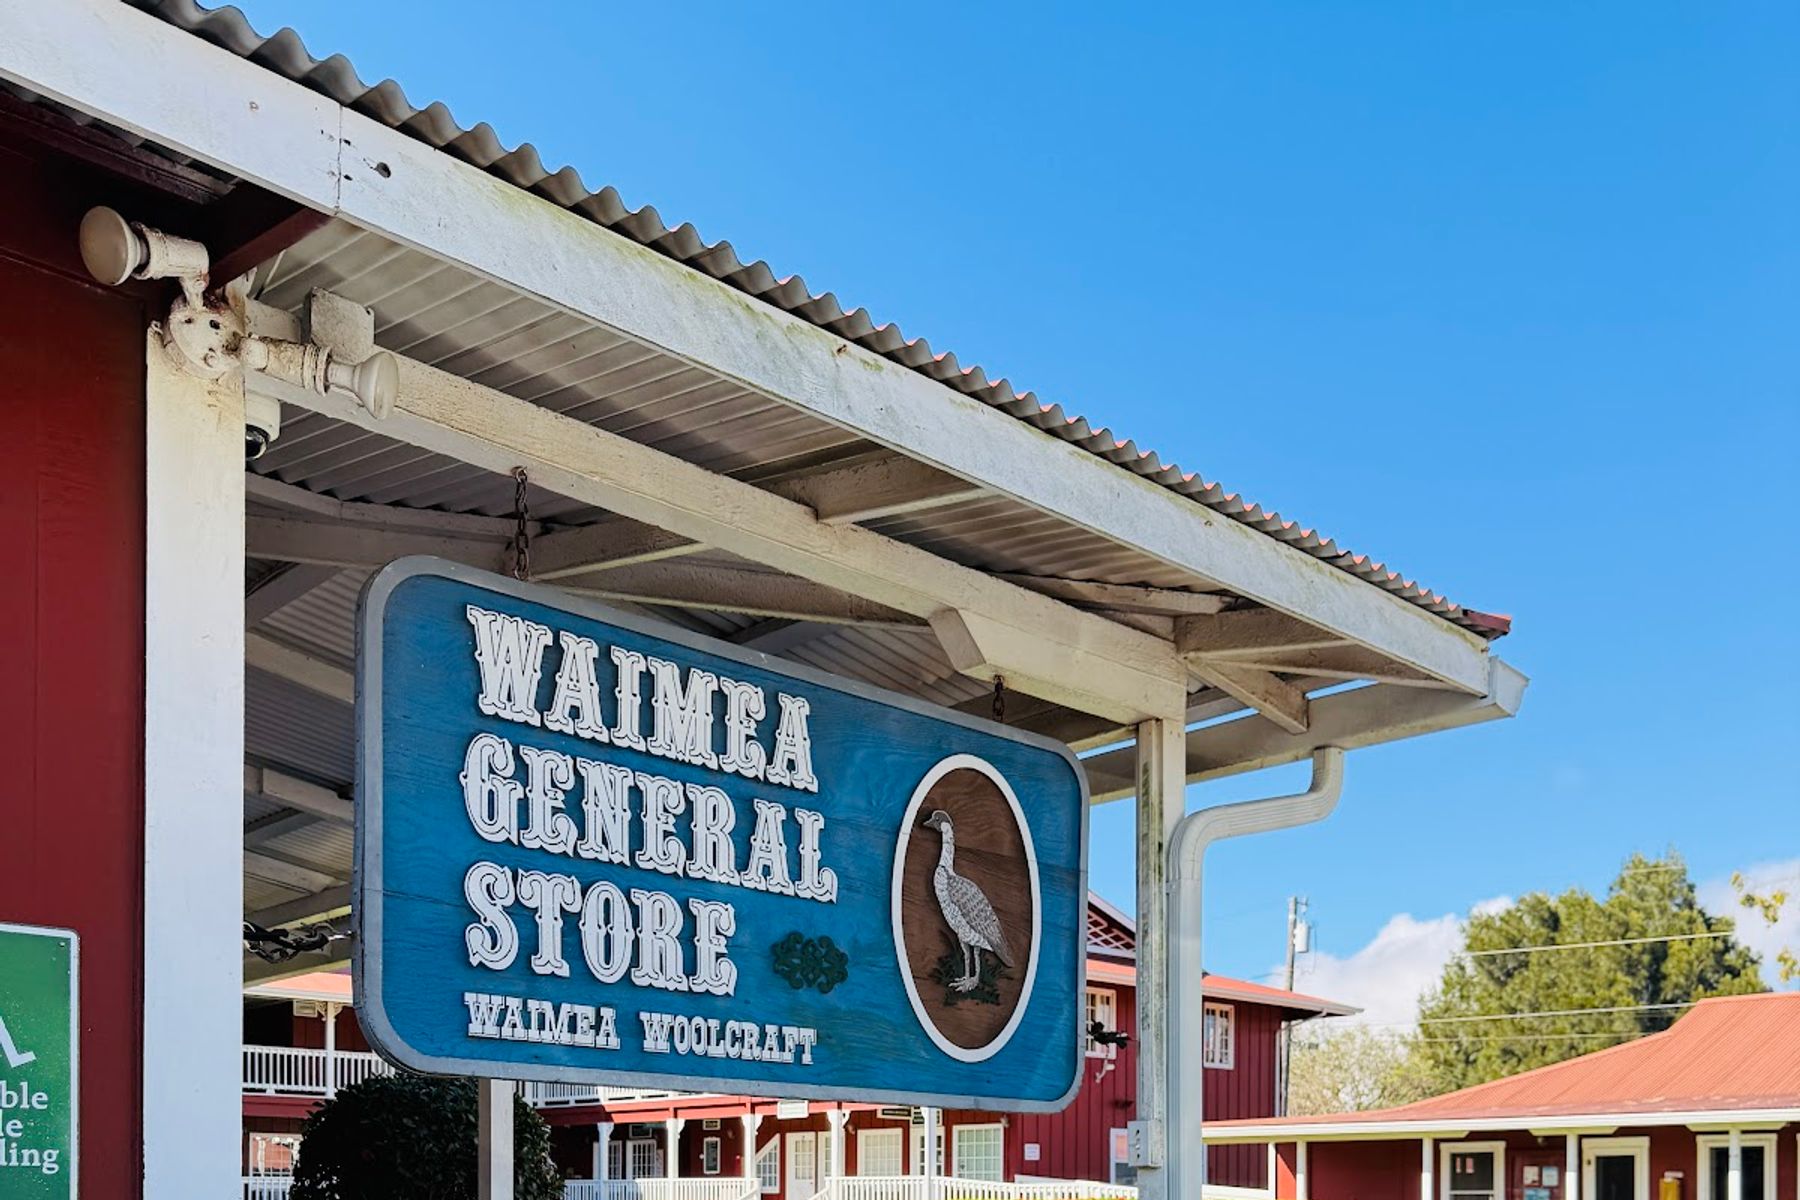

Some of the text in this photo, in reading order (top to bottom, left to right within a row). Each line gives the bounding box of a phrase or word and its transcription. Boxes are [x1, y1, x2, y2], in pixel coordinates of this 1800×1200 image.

[468, 605, 819, 793] WAIMEA
[460, 732, 838, 903] GENERAL
[464, 861, 737, 996] STORE
[464, 992, 817, 1065] WAIMEA WOOLCRAFT
